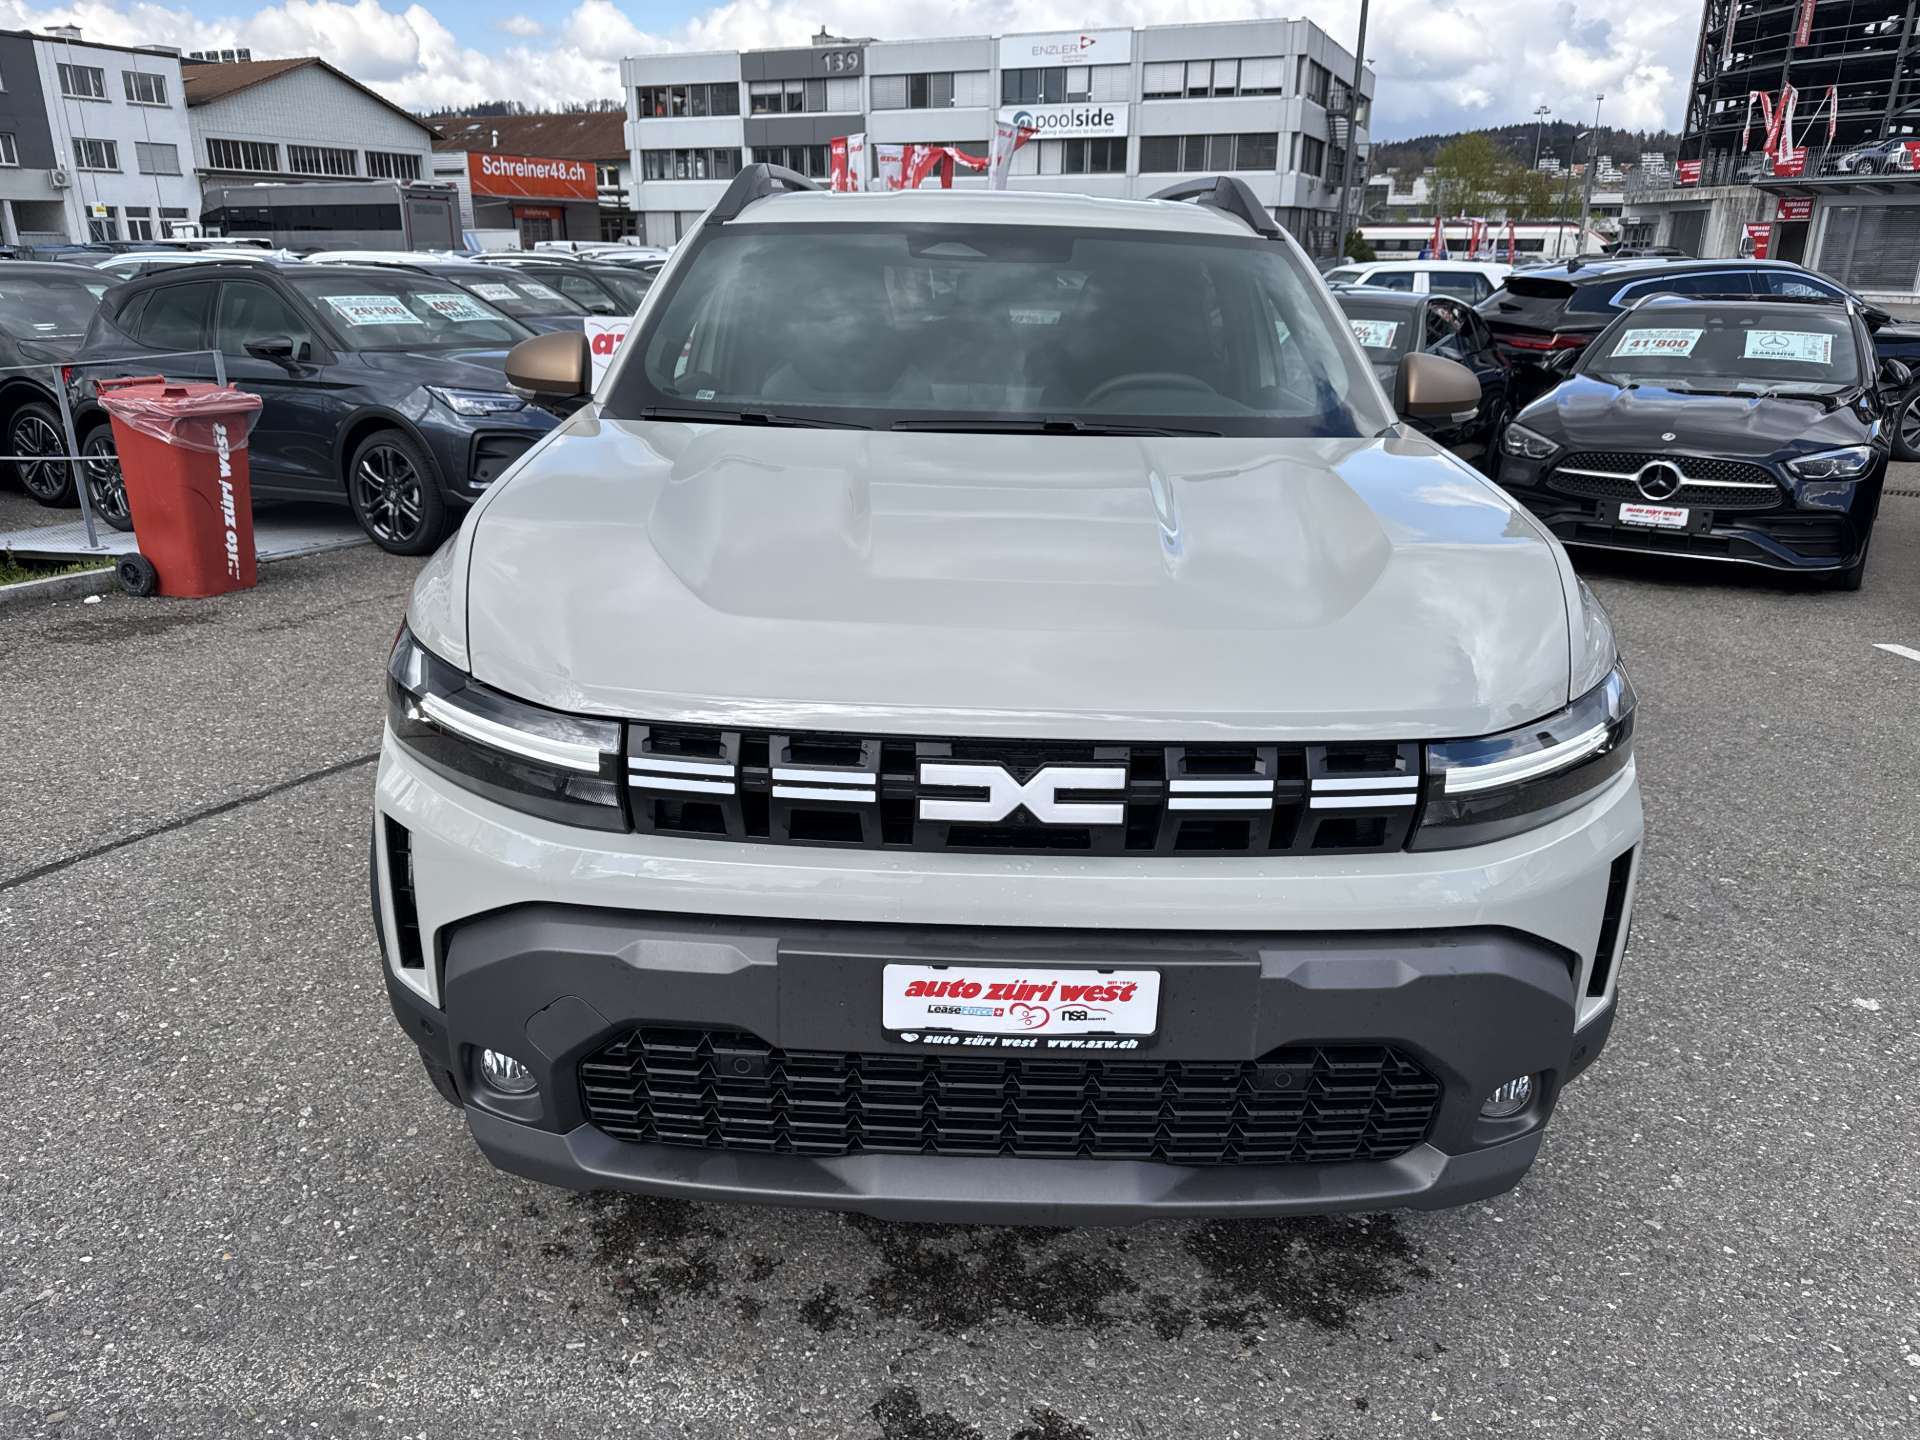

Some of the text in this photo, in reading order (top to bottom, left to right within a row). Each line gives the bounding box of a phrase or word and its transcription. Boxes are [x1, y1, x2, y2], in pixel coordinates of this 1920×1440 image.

[1031, 44, 1078, 56] ENZLER
[822, 51, 859, 72] 139
[1035, 107, 1114, 129] poolside
[482, 155, 585, 180] Schreiner48.ch
[1629, 339, 1690, 349] 41'800
[904, 978, 1138, 1002] auto züri west
[927, 1004, 993, 1017] LeaseForce
[1061, 1010, 1088, 1021] nsa
[923, 1034, 1139, 1049] auto züri west www.azw.ch
